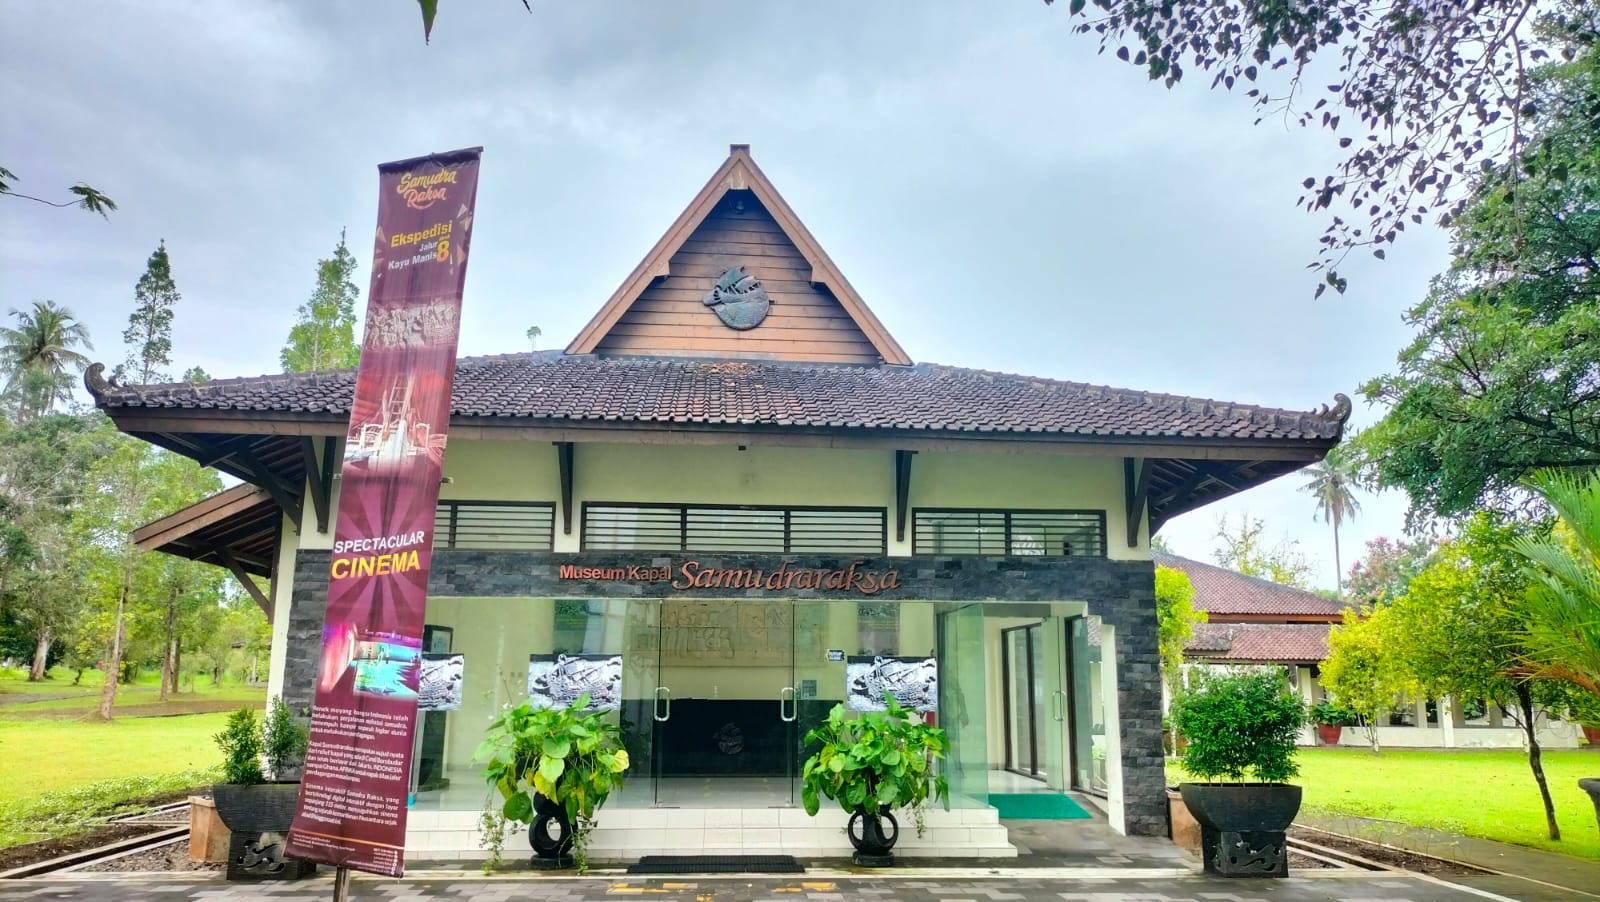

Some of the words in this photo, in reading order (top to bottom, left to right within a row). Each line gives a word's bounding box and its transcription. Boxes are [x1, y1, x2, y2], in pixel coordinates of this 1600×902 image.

[396, 168, 457, 194] Samudra
[403, 186, 447, 209] Raksa
[390, 220, 452, 248] Ekspedisi
[419, 241, 438, 252] Jalur
[436, 240, 450, 263] 8
[387, 259, 410, 270] Kayu
[412, 251, 437, 265] Manis
[334, 530, 425, 554] SPECTACULAR
[331, 549, 421, 580] CINEMA
[559, 565, 626, 580] Museum
[627, 565, 673, 581] Kapal
[672, 560, 900, 594] Samudraraksa
